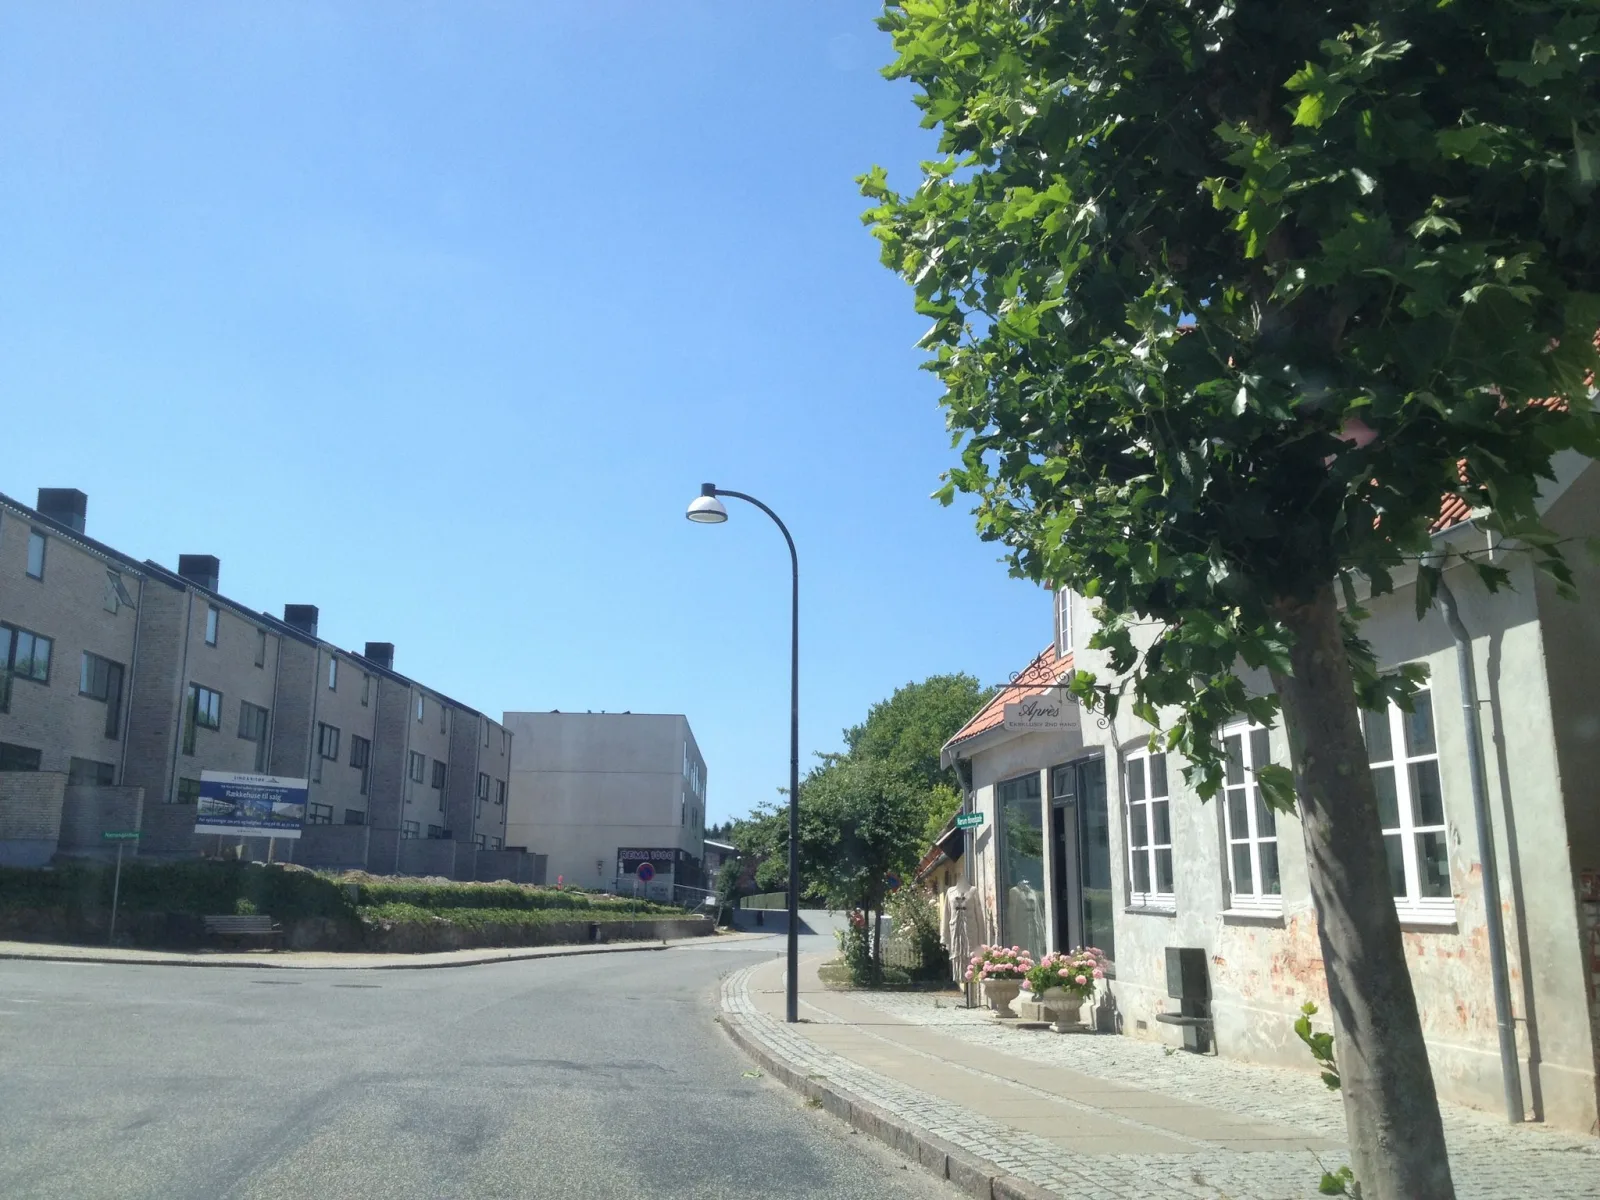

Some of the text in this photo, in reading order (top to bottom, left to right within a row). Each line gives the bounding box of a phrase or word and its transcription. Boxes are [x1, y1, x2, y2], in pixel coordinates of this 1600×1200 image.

[1018, 701, 1060, 721] Après
[226, 790, 261, 799] Rækkehuse
[269, 794, 282, 802] salg
[621, 850, 674, 860] REMA 1000
